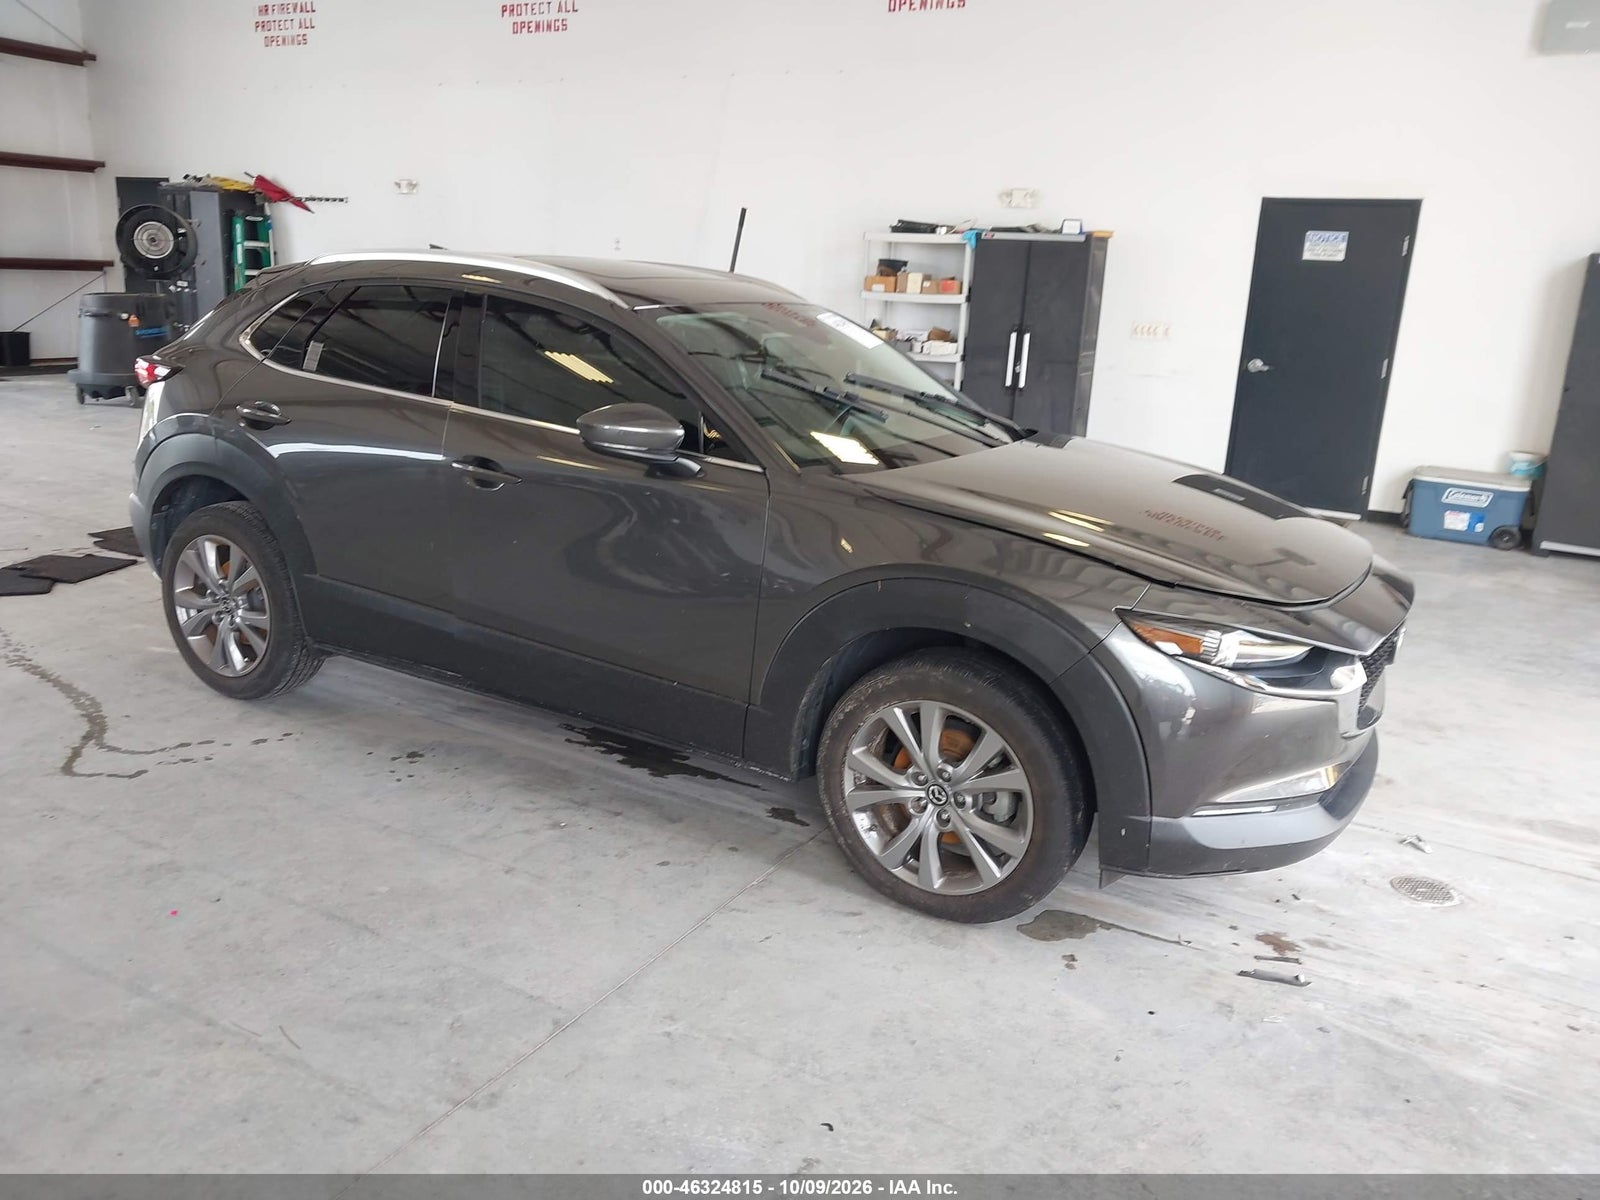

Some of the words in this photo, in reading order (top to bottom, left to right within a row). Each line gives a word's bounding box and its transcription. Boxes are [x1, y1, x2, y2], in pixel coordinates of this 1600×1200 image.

[271, 1, 316, 15] FIREWALL
[501, 2, 552, 18] PROTECT
[557, 0, 578, 13] ALL
[254, 18, 294, 32] PROTECT
[298, 17, 315, 29] ALL
[512, 18, 568, 34] OPENINGS
[264, 33, 308, 47] OPENINGS
